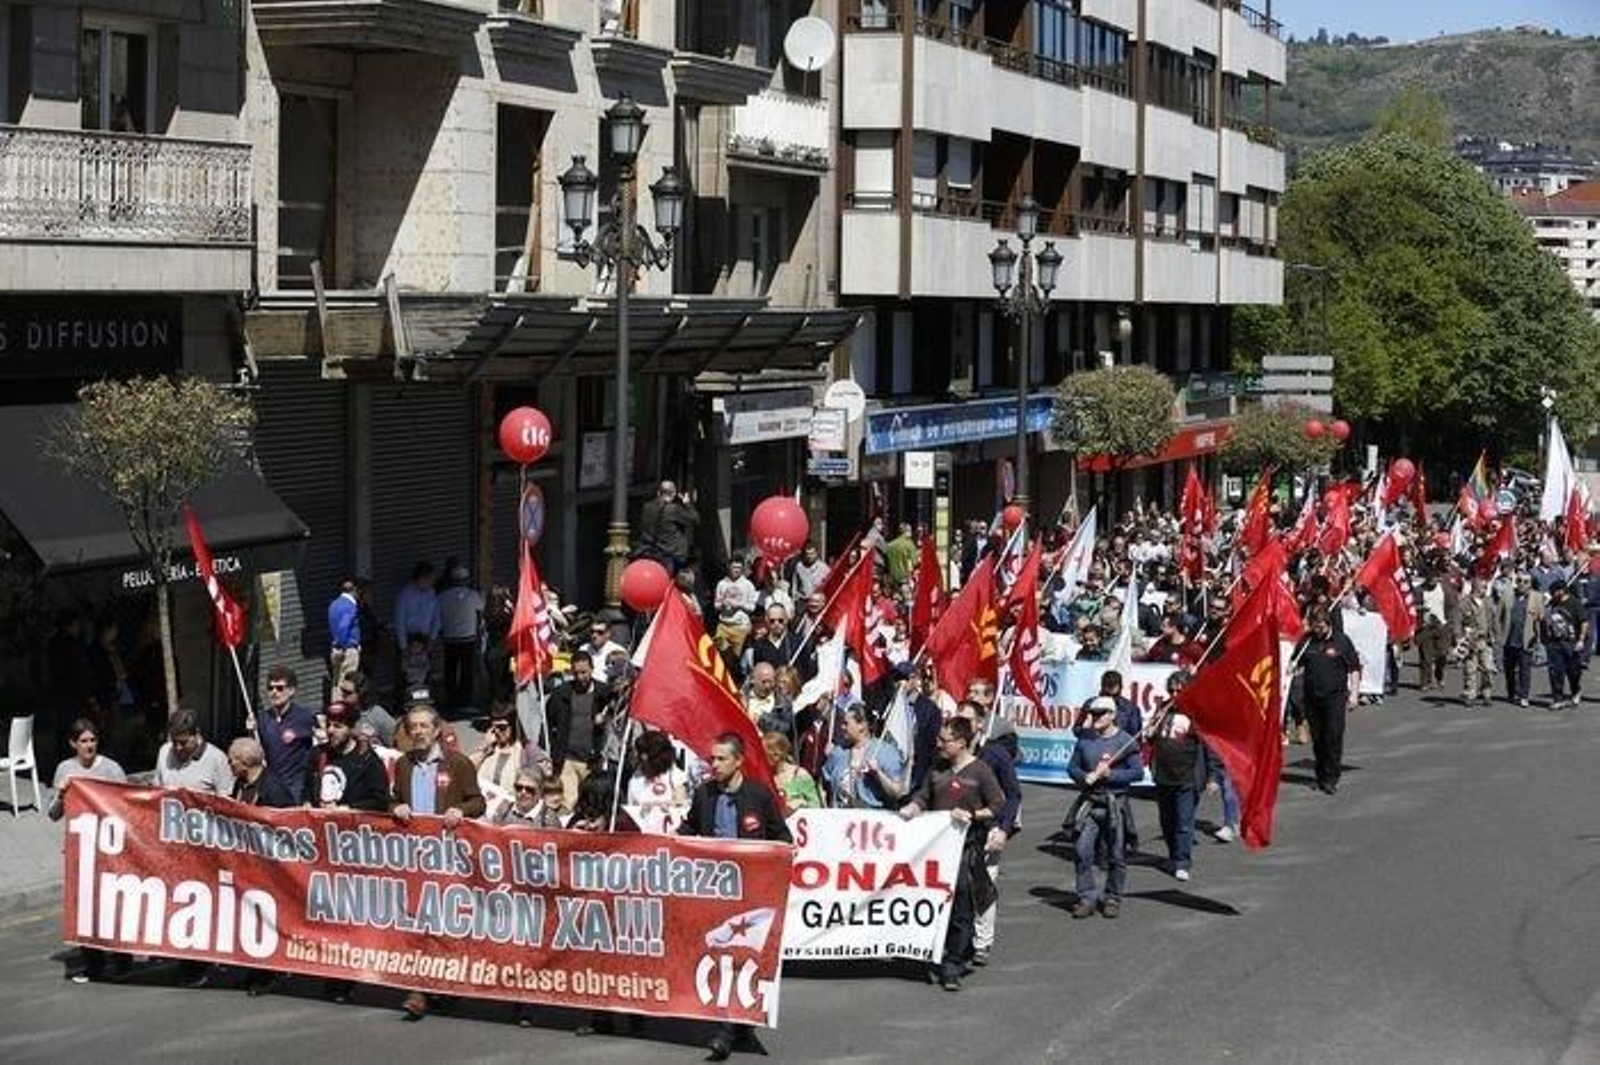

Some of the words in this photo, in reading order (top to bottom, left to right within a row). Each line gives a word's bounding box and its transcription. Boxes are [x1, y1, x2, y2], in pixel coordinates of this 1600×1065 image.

[27, 320, 169, 349] DIFFUSION
[160, 797, 318, 862] Reformas
[325, 822, 473, 878] laborais
[479, 844, 502, 882] e
[510, 840, 559, 888] lei
[571, 848, 742, 899] mordaza
[792, 859, 952, 893] ONAL
[99, 870, 278, 958] maio
[307, 872, 545, 948] ANULACIÓN
[552, 895, 667, 956] XA!!!
[321, 938, 467, 982] internacional
[470, 957, 497, 986] da
[501, 963, 568, 992] clase
[572, 967, 669, 1002] obreira
